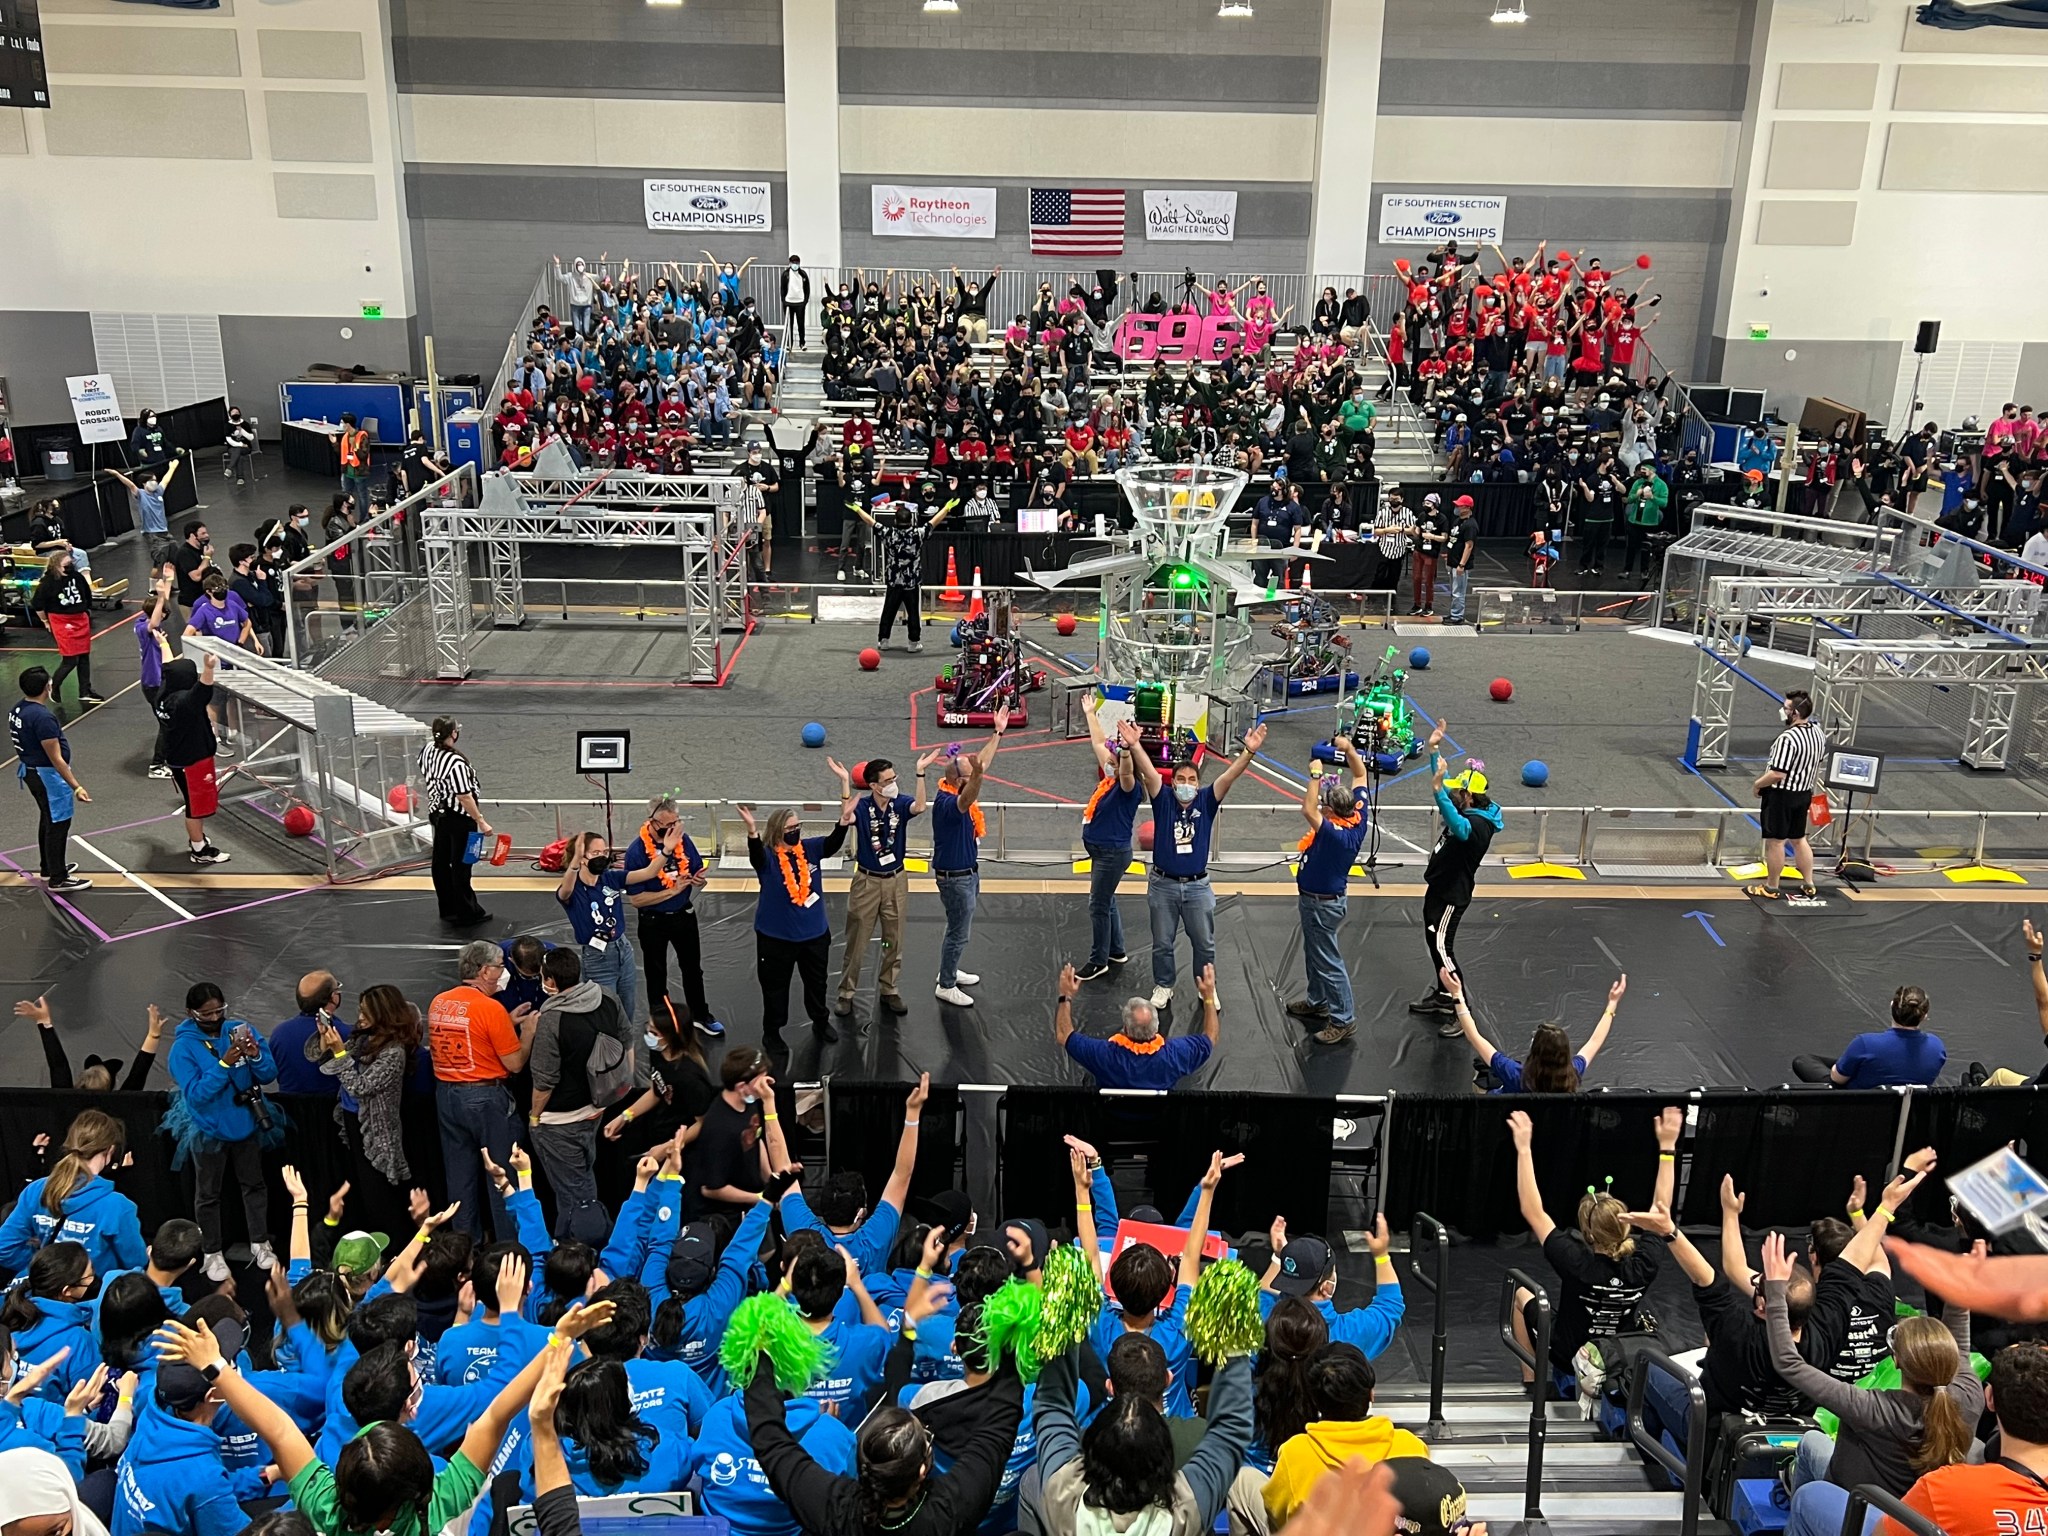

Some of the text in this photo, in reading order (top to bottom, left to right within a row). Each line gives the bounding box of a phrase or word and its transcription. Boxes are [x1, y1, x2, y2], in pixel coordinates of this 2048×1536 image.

[650, 183, 765, 195] CIF SOUTHERN SECTION
[694, 197, 724, 210] Ford
[910, 197, 970, 212] Raytheon
[1387, 198, 1500, 209] CIF SOUTHERN SECTION
[652, 211, 765, 225] CHAMPIONSHIPS
[910, 211, 987, 227] Technologies
[1149, 203, 1230, 235] Walt Disney
[1429, 211, 1457, 223] Ford
[1151, 225, 1215, 234] IMAGINEERING
[1386, 226, 1496, 238] CHAMPIONSHIPS
[1112, 313, 1241, 361] 696
[85, 408, 111, 417] ROBOT
[80, 415, 121, 425] CROSSING
[1301, 680, 1318, 692] 294
[943, 712, 968, 725] 4501
[434, 998, 471, 1016] 3476
[466, 1346, 498, 1356] TEAM
[827, 1377, 853, 1390] 2637
[229, 1432, 258, 1444] 2637
[488, 1426, 522, 1480] LIANCE
[1993, 1506, 2048, 1536] 34
